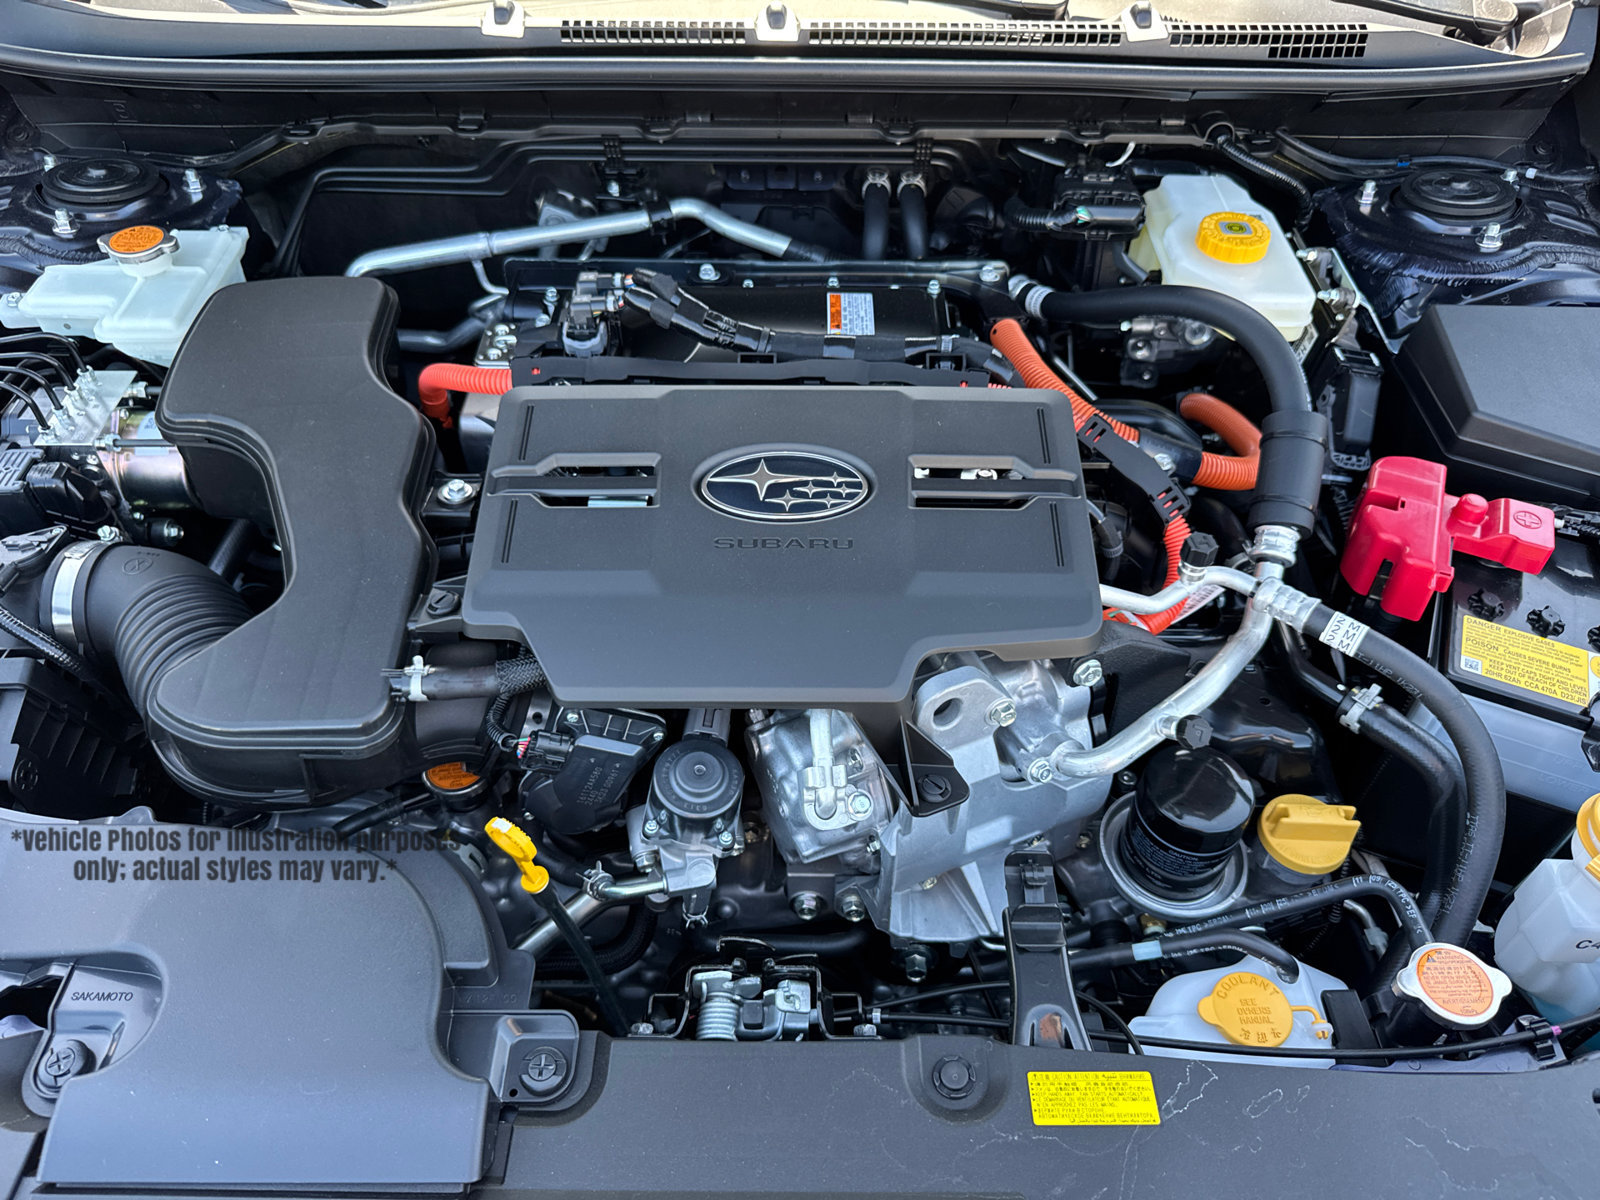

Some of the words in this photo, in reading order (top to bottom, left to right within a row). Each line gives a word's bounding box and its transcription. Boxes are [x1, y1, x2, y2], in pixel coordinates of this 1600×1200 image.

[714, 537, 854, 550] SUBARU
[1466, 617, 1501, 631] DANGER
[1503, 628, 1534, 641] EXPLOSIVE
[1535, 638, 1555, 648] GASES
[1466, 636, 1499, 652] POISON
[1503, 649, 1527, 659] CAUSES
[1528, 655, 1550, 665] SEVERE
[1551, 662, 1571, 673] BURNS
[1485, 669, 1503, 680] 20HR
[1503, 673, 1521, 684] 62Ah
[1524, 680, 1540, 690] CCA
[1540, 686, 1558, 696] 470A
[1488, 664, 1504, 672] KEEP
[1527, 674, 1548, 685] REACH
[1557, 683, 1587, 697] CHILDREN
[1489, 659, 1504, 667] KEEP
[1505, 663, 1521, 671] VENT
[1521, 668, 1537, 677] CAPS
[1538, 672, 1555, 682] TIGHT
[1556, 678, 1569, 686] AND
[1569, 682, 1587, 692] LEVEL
[1168, 849, 1199, 861] CAUTION
[71, 992, 133, 1001] SAKAMOTO
[1216, 975, 1280, 1000] COOLANT
[1236, 1007, 1272, 1015] OWNERS
[1239, 998, 1257, 1006] SEE
[1239, 1015, 1274, 1025] MANUAL
